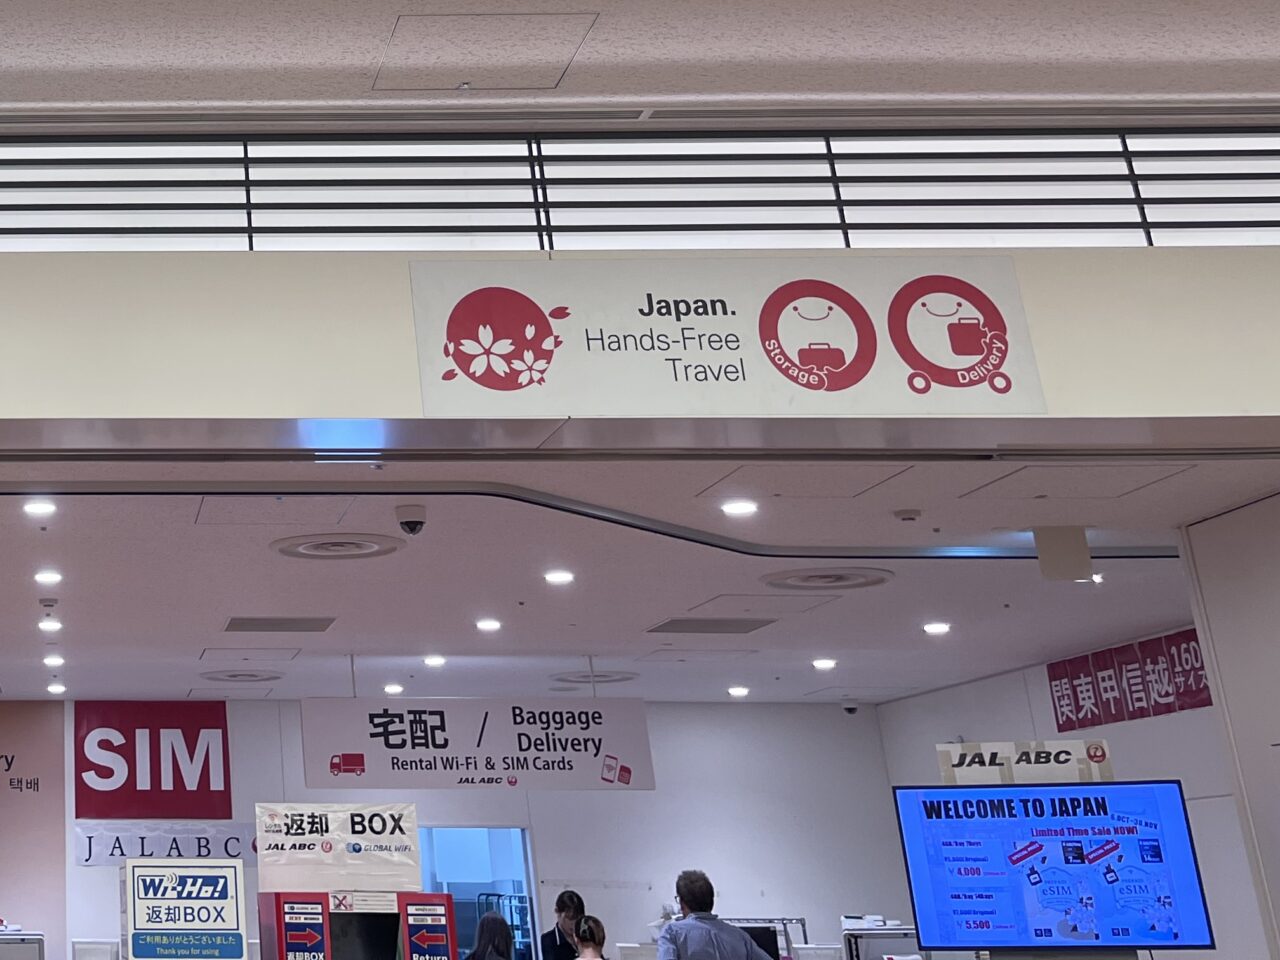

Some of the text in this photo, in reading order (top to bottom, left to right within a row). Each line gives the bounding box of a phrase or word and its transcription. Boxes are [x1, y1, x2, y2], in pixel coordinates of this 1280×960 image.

[638, 293, 737, 322] Japan.
[585, 327, 740, 352] Hands-Free
[665, 357, 746, 382] Travel
[765, 339, 819, 385] Storage
[957, 338, 1006, 384] Delivery
[1170, 641, 1202, 672] 160
[1051, 655, 1176, 725] 関東甲信越
[368, 708, 449, 750] 宅配
[511, 706, 603, 730] Baggage
[517, 733, 603, 757] Delivery
[81, 727, 225, 791] SIM
[391, 756, 574, 771] Rental Wi-Fi & SIM Cards
[951, 750, 1072, 768] JAL ABC
[9, 777, 40, 792] 택배
[922, 796, 1108, 820] WELCOME TO JAPAN
[284, 812, 406, 836] 返却 BOX
[1031, 825, 1139, 837] Limited Time Sale NOW!
[363, 844, 392, 852] GLOBAL
[139, 878, 225, 898] Wi-Ho!
[1042, 886, 1072, 896] eSIM
[1119, 885, 1149, 895] eSIM
[146, 905, 226, 923] 返却BOX
[138, 935, 236, 945] ご利用ありがとうございました
[156, 947, 176, 955] Thank
[191, 947, 200, 955] for
[201, 948, 219, 956] using
